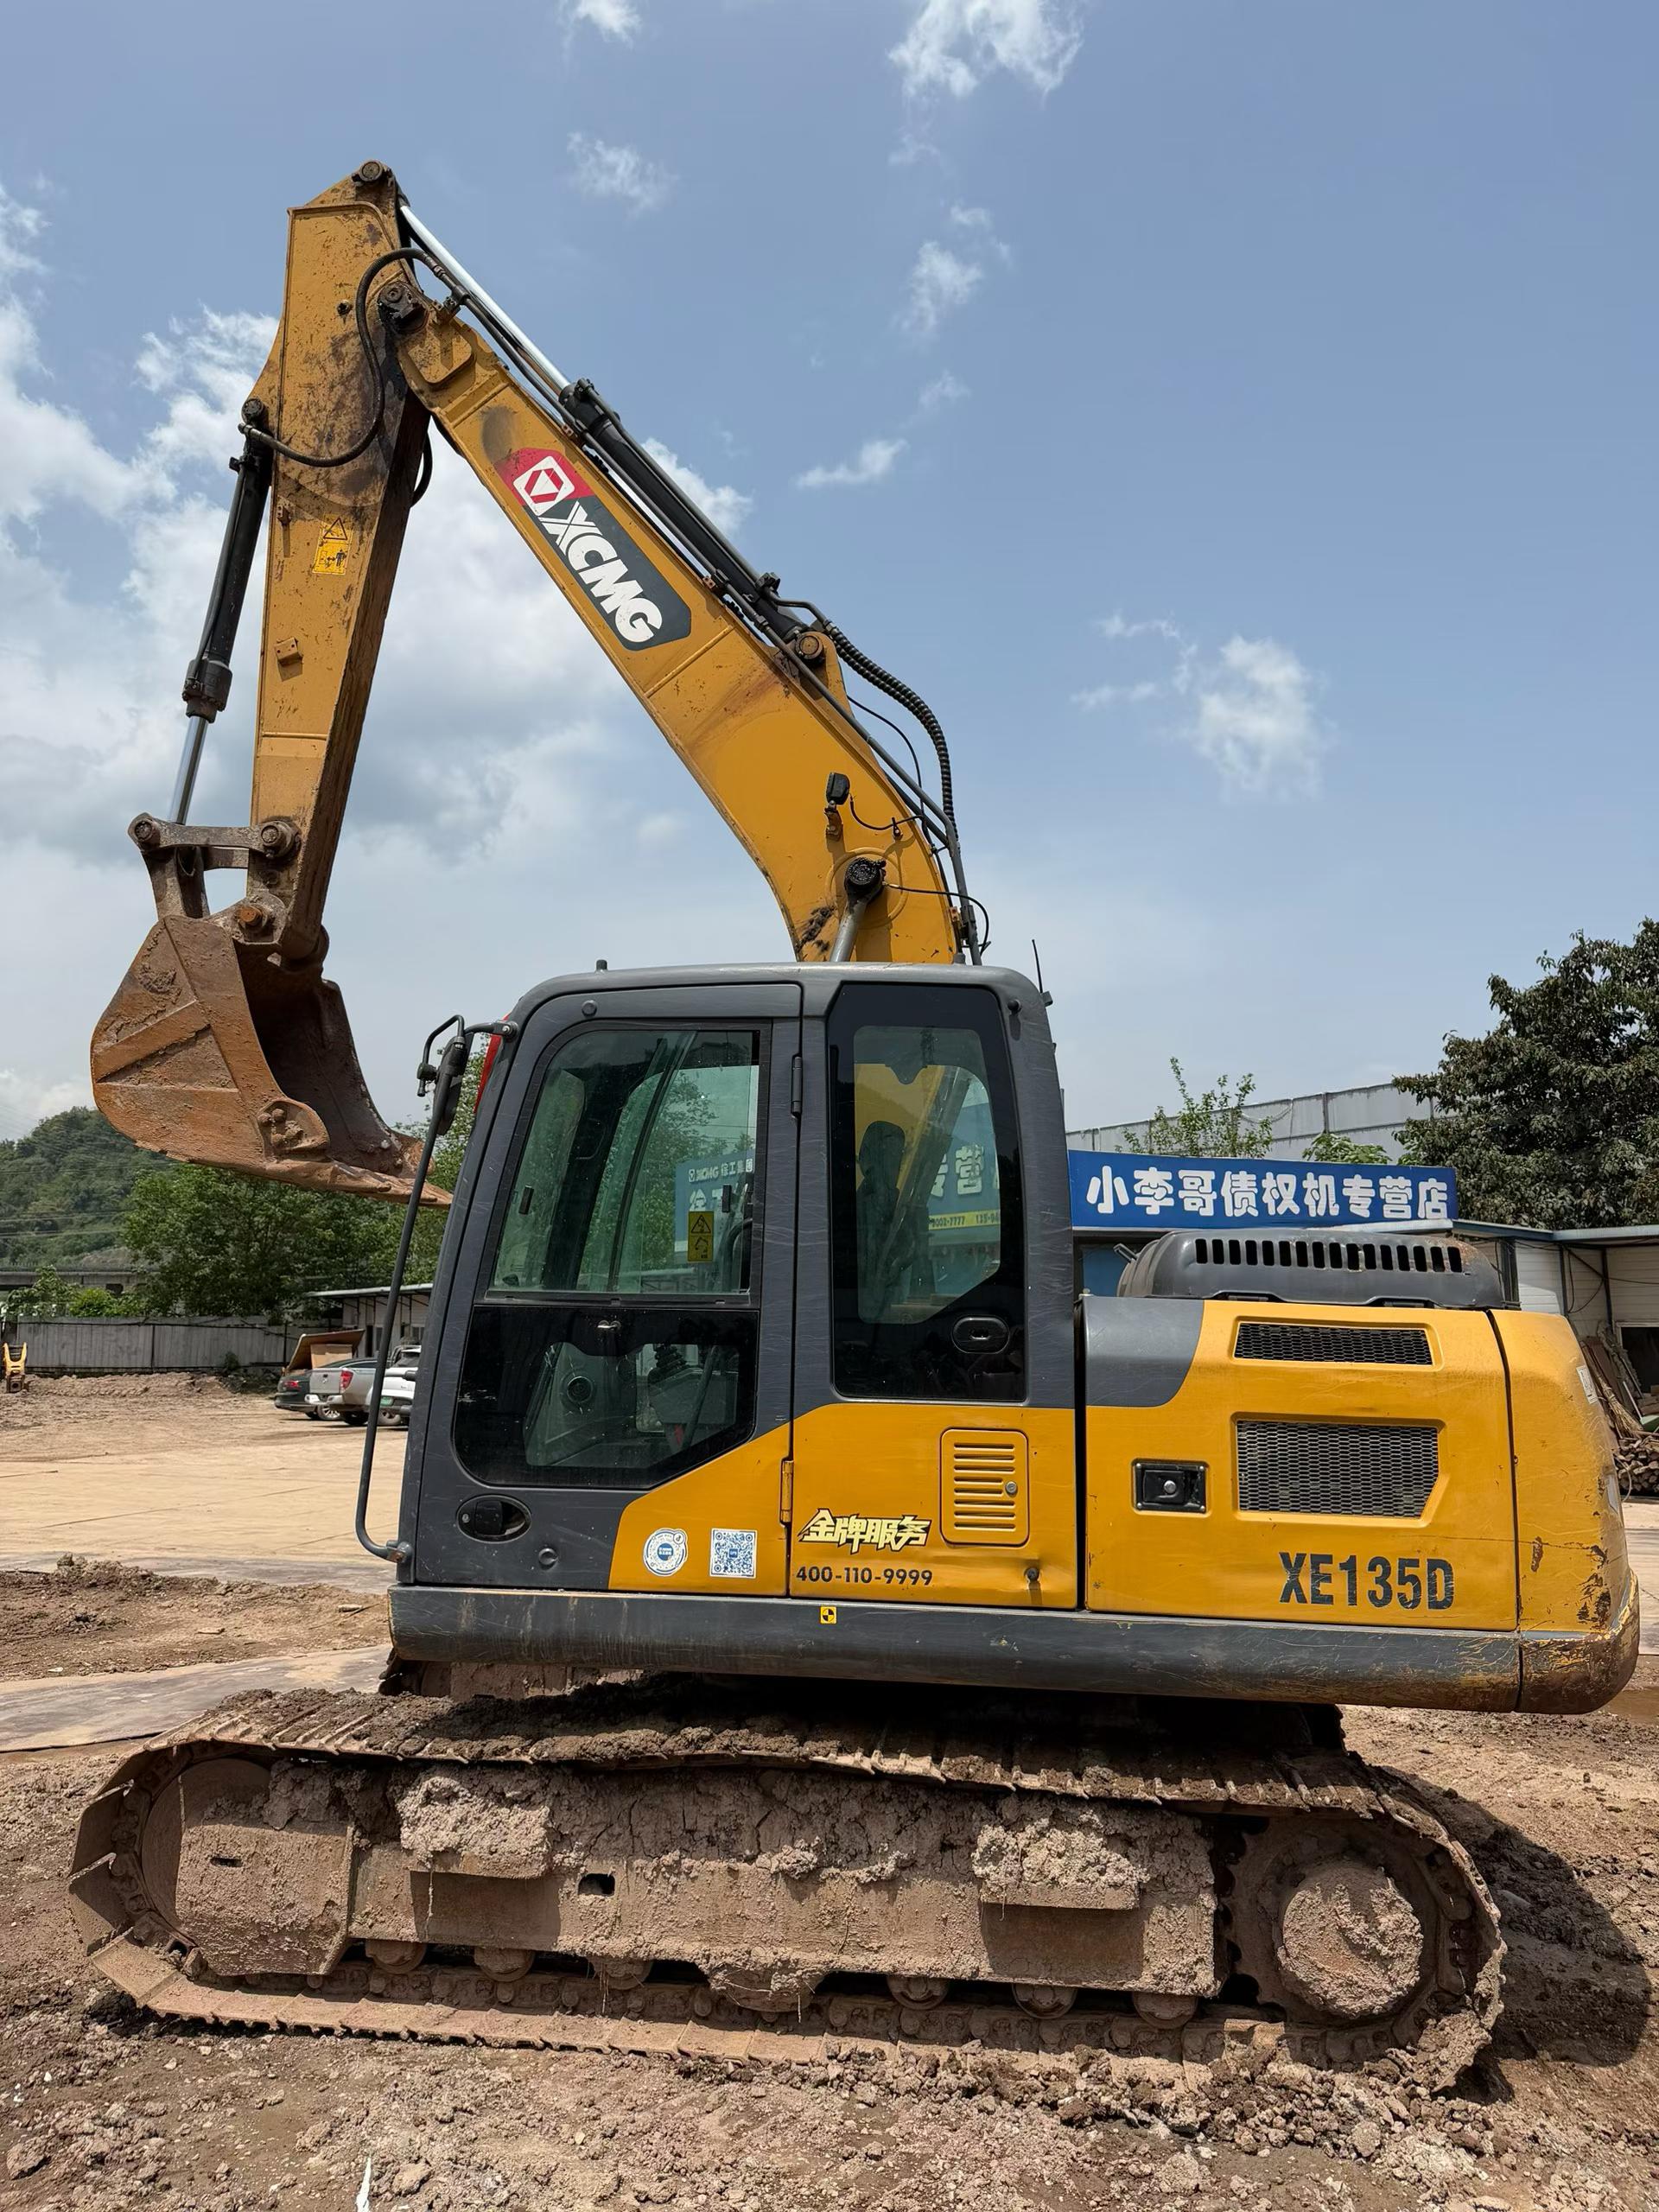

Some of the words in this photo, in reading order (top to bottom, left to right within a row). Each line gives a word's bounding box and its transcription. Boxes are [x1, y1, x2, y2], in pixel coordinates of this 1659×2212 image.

[539, 501, 663, 643] XCMG
[1086, 1166, 1448, 1219] 小李哥债权机专营店
[798, 1508, 931, 1554] 金牌服务
[796, 1566, 933, 1586] 400-110-9999
[1279, 1552, 1455, 1611] XE135D
